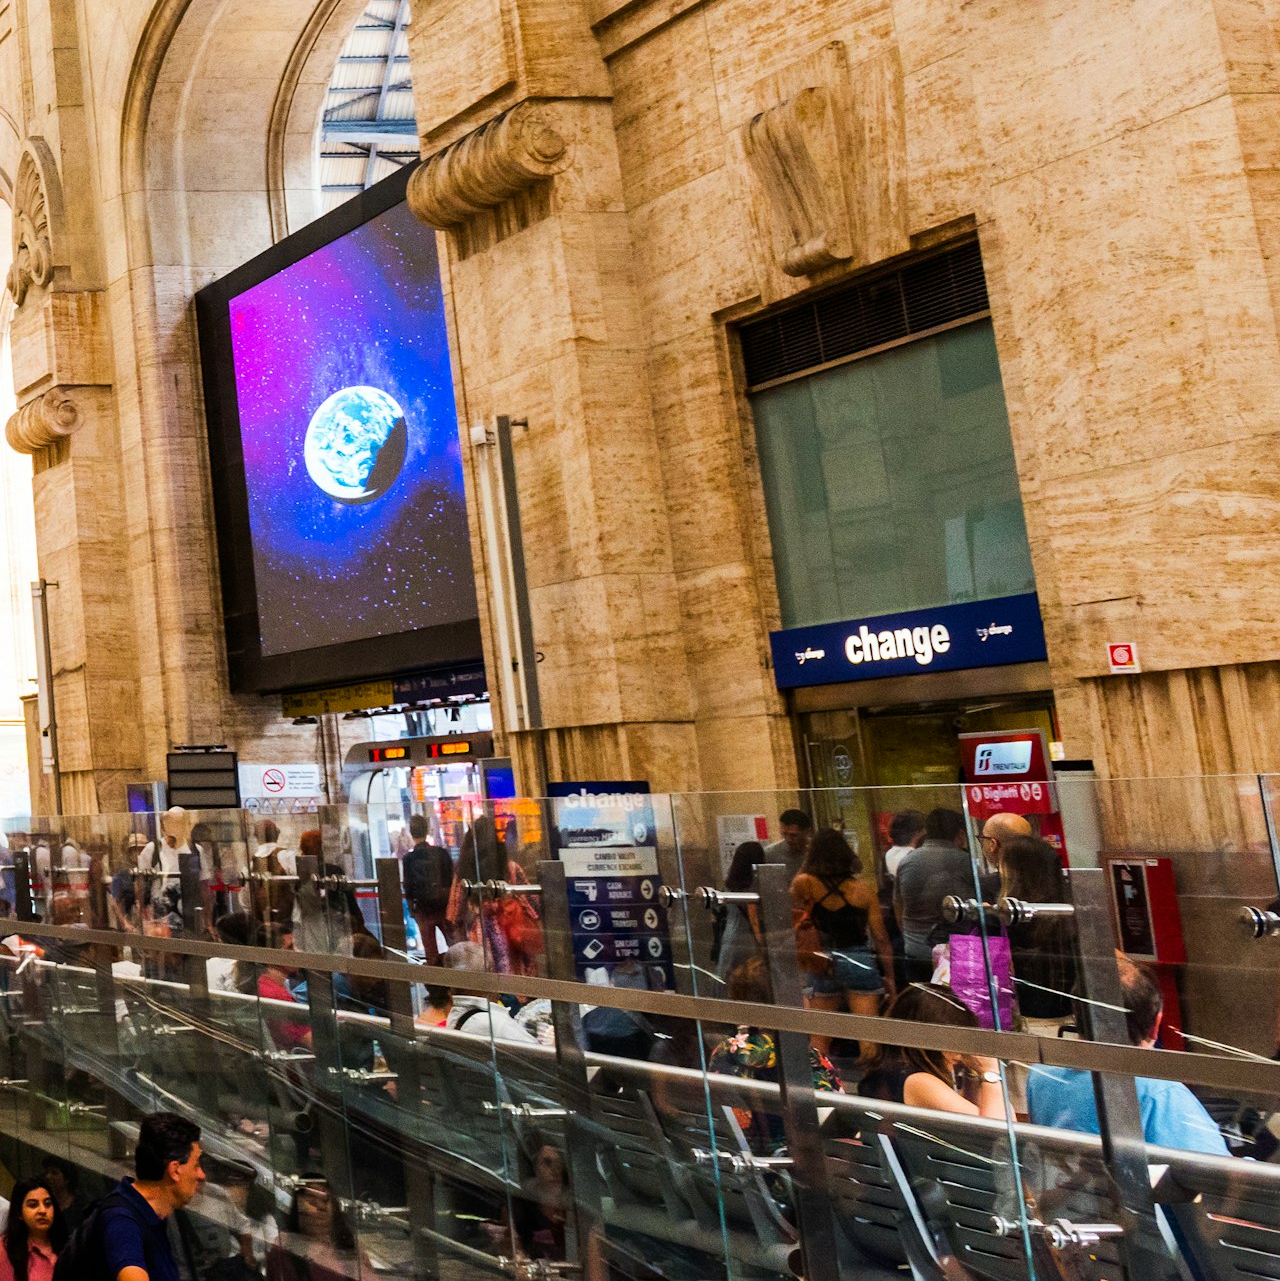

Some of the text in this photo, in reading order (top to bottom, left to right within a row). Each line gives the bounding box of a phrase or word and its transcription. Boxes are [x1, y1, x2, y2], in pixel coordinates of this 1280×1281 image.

[844, 623, 951, 665] change
[564, 788, 645, 812] change
[983, 786, 1019, 801] Biglietti
